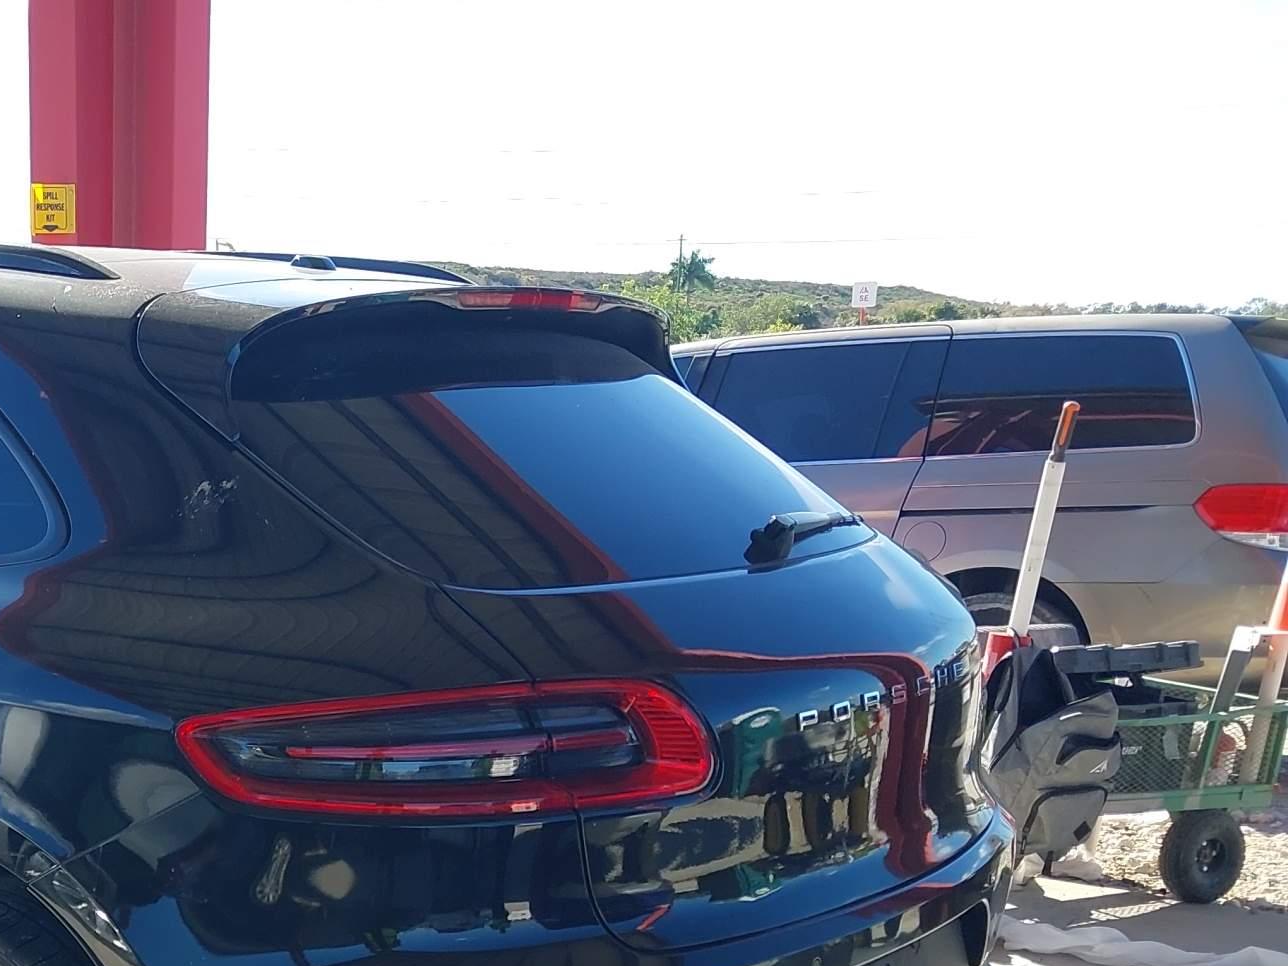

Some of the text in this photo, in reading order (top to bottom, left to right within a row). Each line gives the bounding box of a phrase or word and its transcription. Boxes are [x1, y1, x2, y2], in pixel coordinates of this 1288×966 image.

[36, 202, 65, 212] RESPONSE
[45, 213, 56, 223] KIT
[798, 661, 966, 733] PORSCHE
